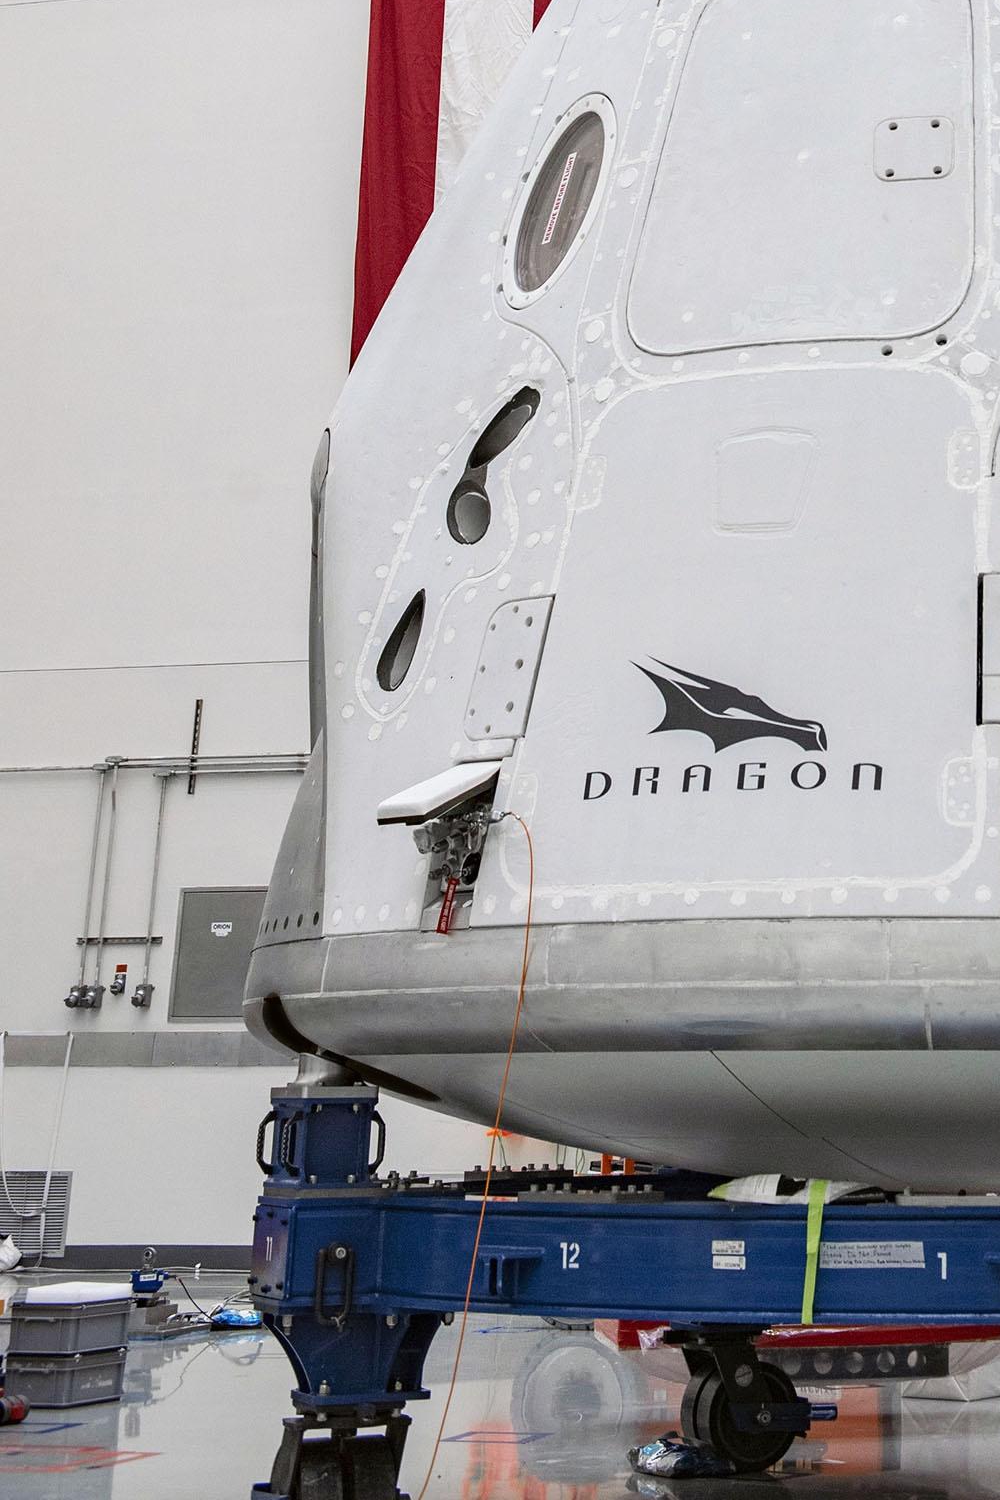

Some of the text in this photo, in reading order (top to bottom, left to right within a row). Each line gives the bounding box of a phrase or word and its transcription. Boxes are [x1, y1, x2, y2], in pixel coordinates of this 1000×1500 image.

[583, 761, 883, 801] DRAGON
[560, 1242, 580, 1269] 12
[937, 1251, 947, 1280] 1
